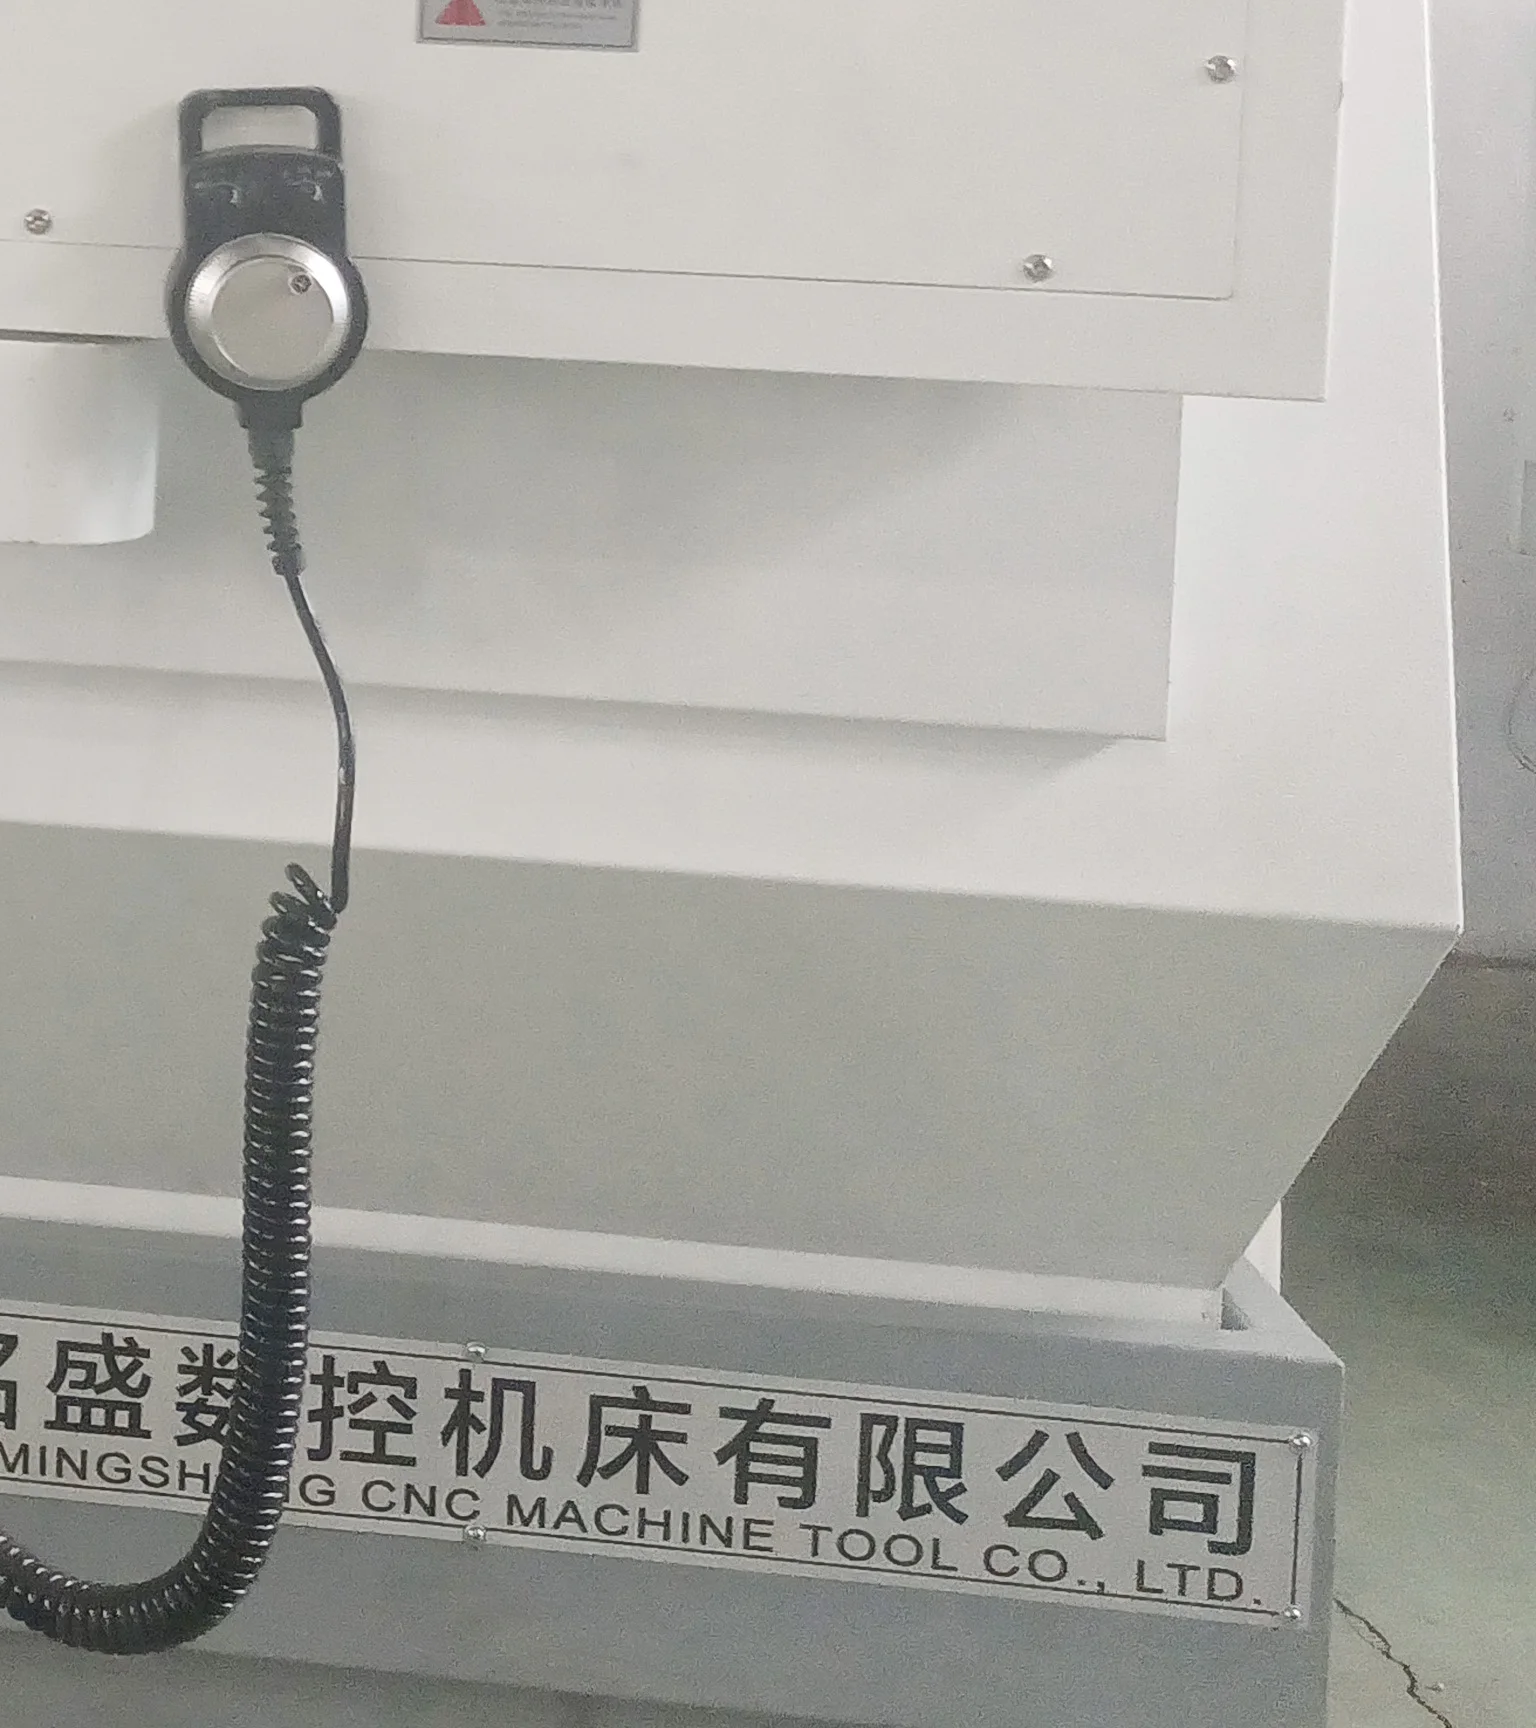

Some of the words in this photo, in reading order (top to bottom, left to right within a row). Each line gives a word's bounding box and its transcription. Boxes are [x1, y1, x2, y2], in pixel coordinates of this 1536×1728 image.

[361, 1479, 481, 1522] CNC
[505, 1492, 776, 1554] MACHINE
[799, 1523, 959, 1572] TOOL
[983, 1543, 1106, 1595] CO.,
[1135, 1559, 1263, 1607] LTD.
